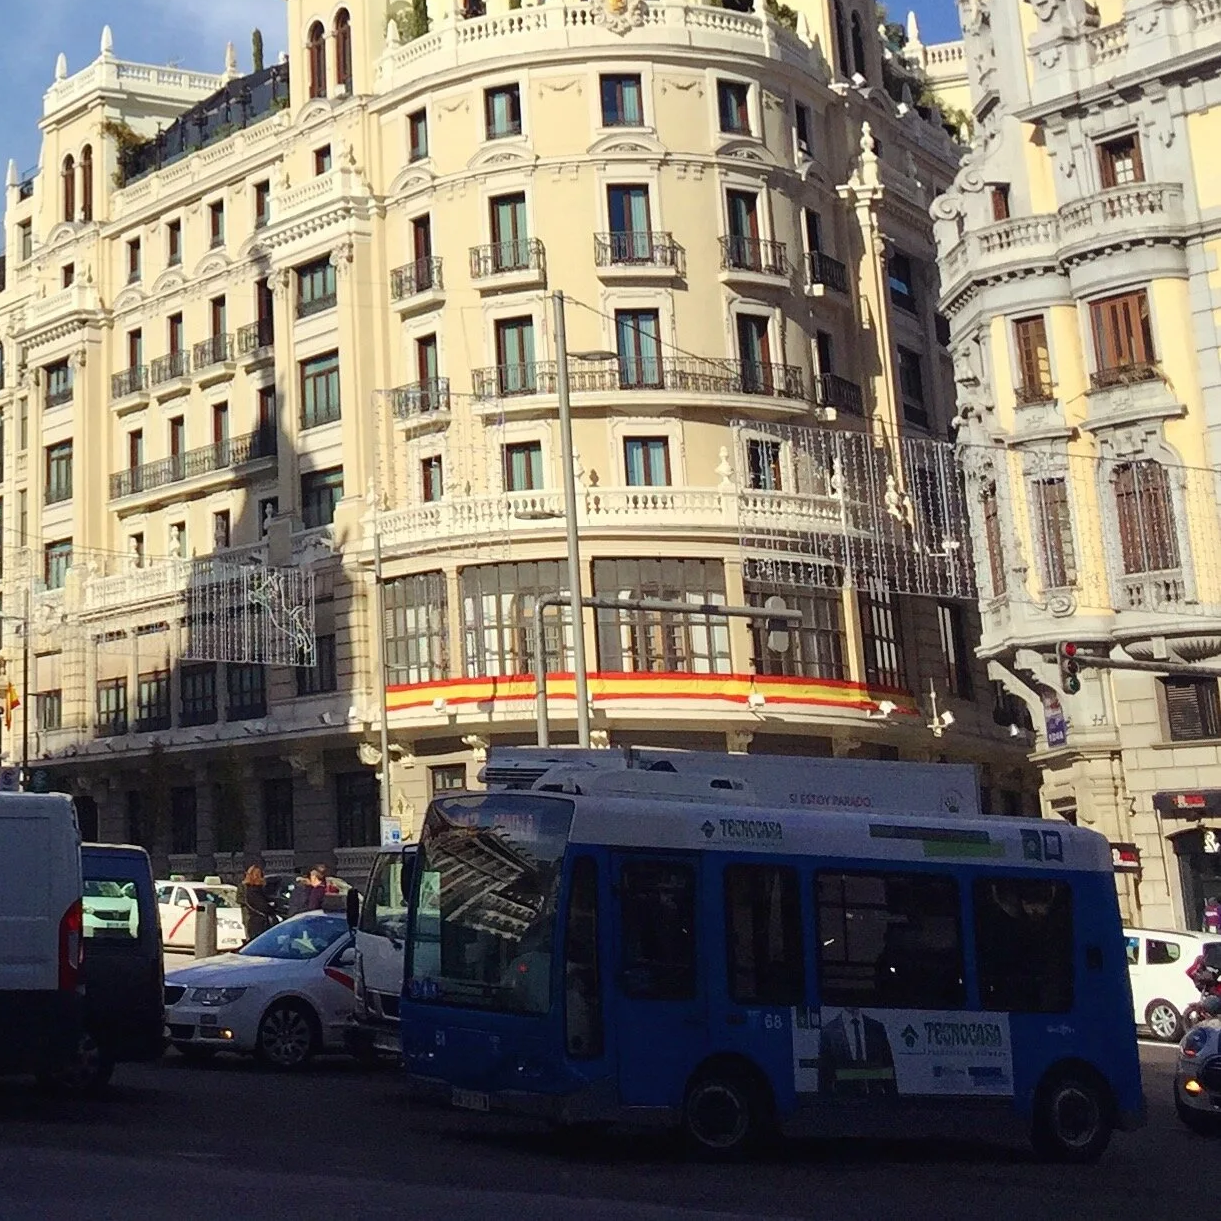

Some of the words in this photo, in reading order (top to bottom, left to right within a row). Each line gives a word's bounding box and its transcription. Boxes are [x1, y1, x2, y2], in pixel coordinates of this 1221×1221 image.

[800, 793, 831, 806] ESTOY
[719, 818, 783, 839] TECNOCASA
[764, 1012, 783, 1029] 68
[923, 1021, 1003, 1047] TECNOCASA
